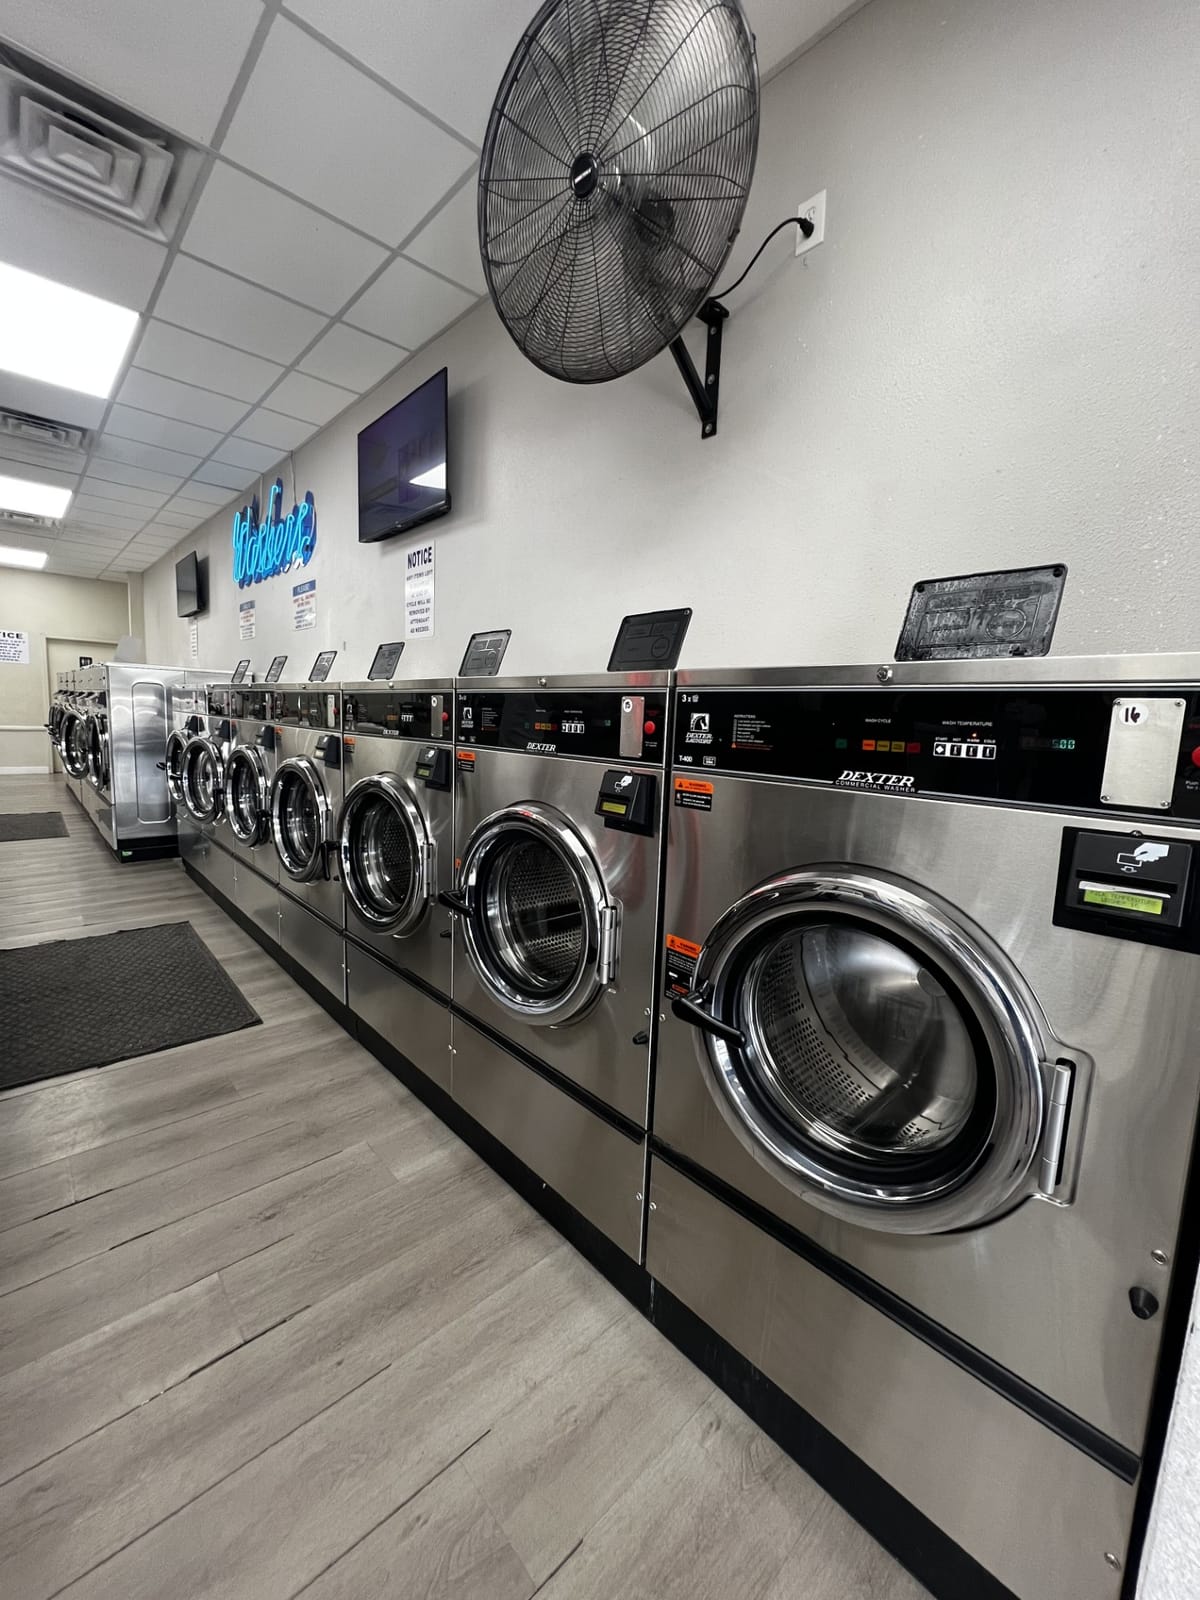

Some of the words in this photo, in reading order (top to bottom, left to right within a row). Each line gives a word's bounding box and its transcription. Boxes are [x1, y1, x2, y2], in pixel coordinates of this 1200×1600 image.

[407, 546, 432, 569] NOTICE
[0, 631, 23, 639] ICE
[1124, 706, 1141, 723] 16
[526, 742, 556, 752] DEXTER
[838, 770, 915, 787] DEXTER
[835, 780, 881, 790] COMMERCIAL
[884, 785, 916, 793] WASHER
